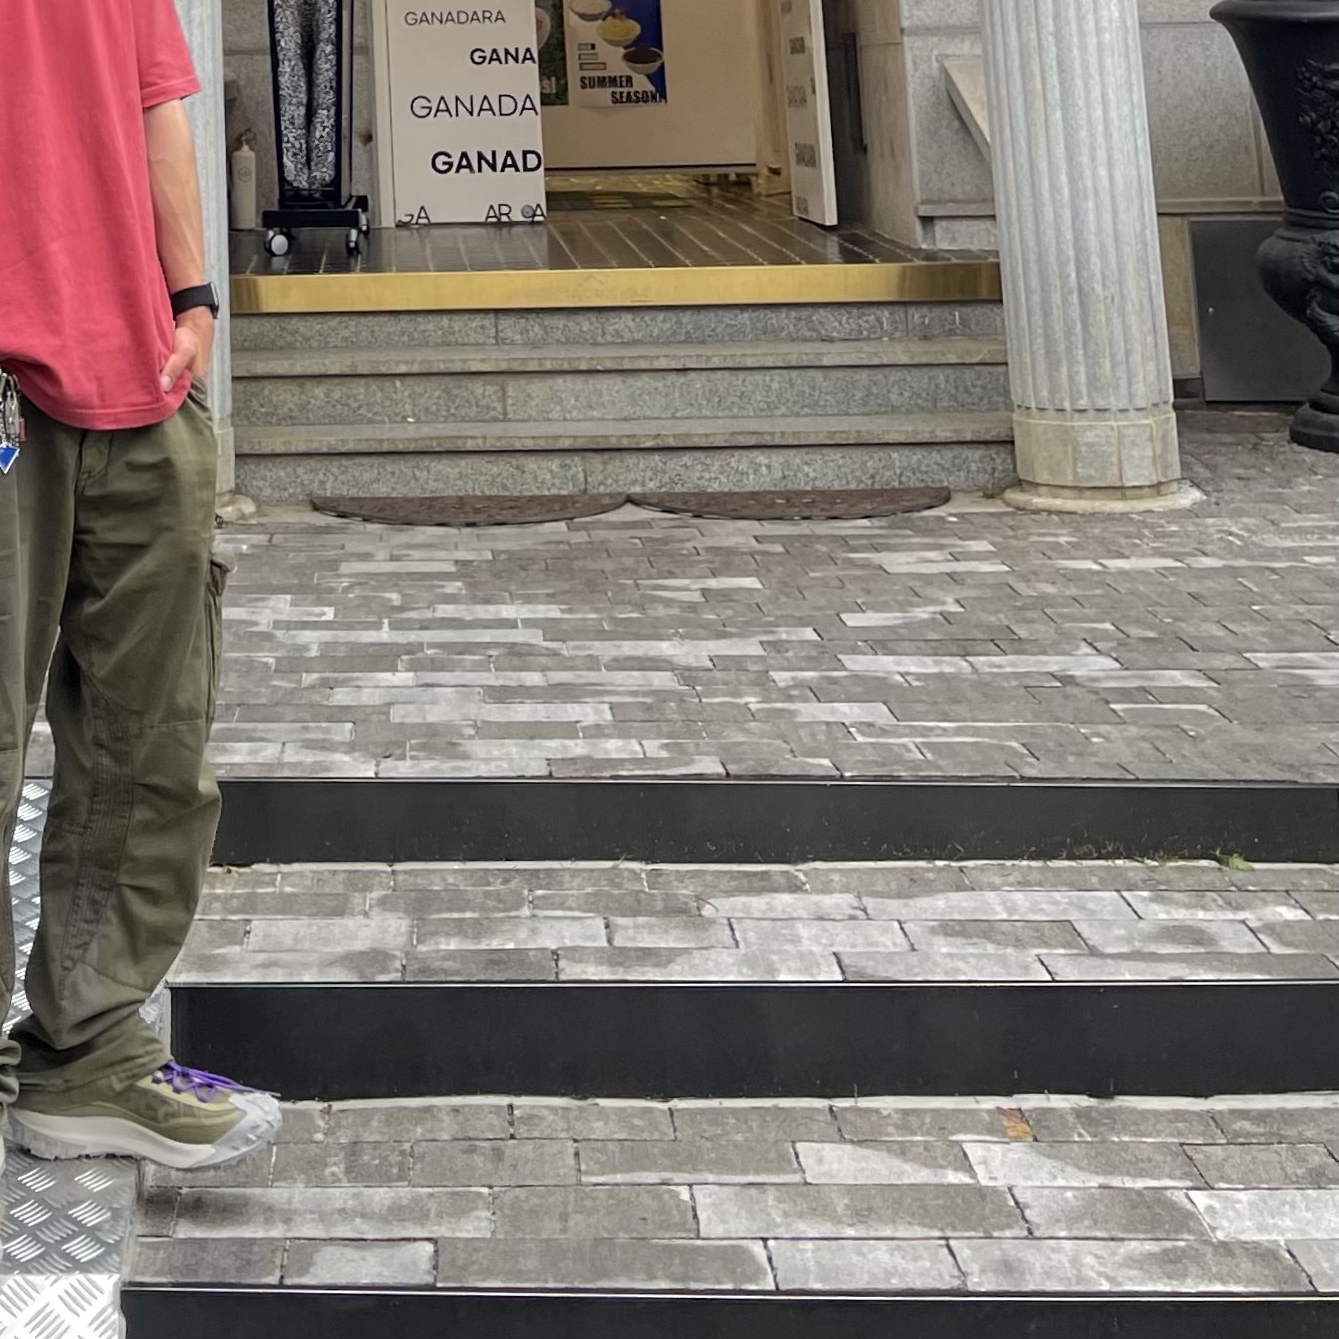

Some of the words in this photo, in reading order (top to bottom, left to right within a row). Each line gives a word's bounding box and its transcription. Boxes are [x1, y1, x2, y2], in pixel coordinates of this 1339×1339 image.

[404, 9, 507, 27] GANADARA
[470, 47, 536, 66] GANA
[580, 75, 633, 90] SUMMER
[411, 93, 539, 119] GANADA
[431, 149, 542, 175] GANAD
